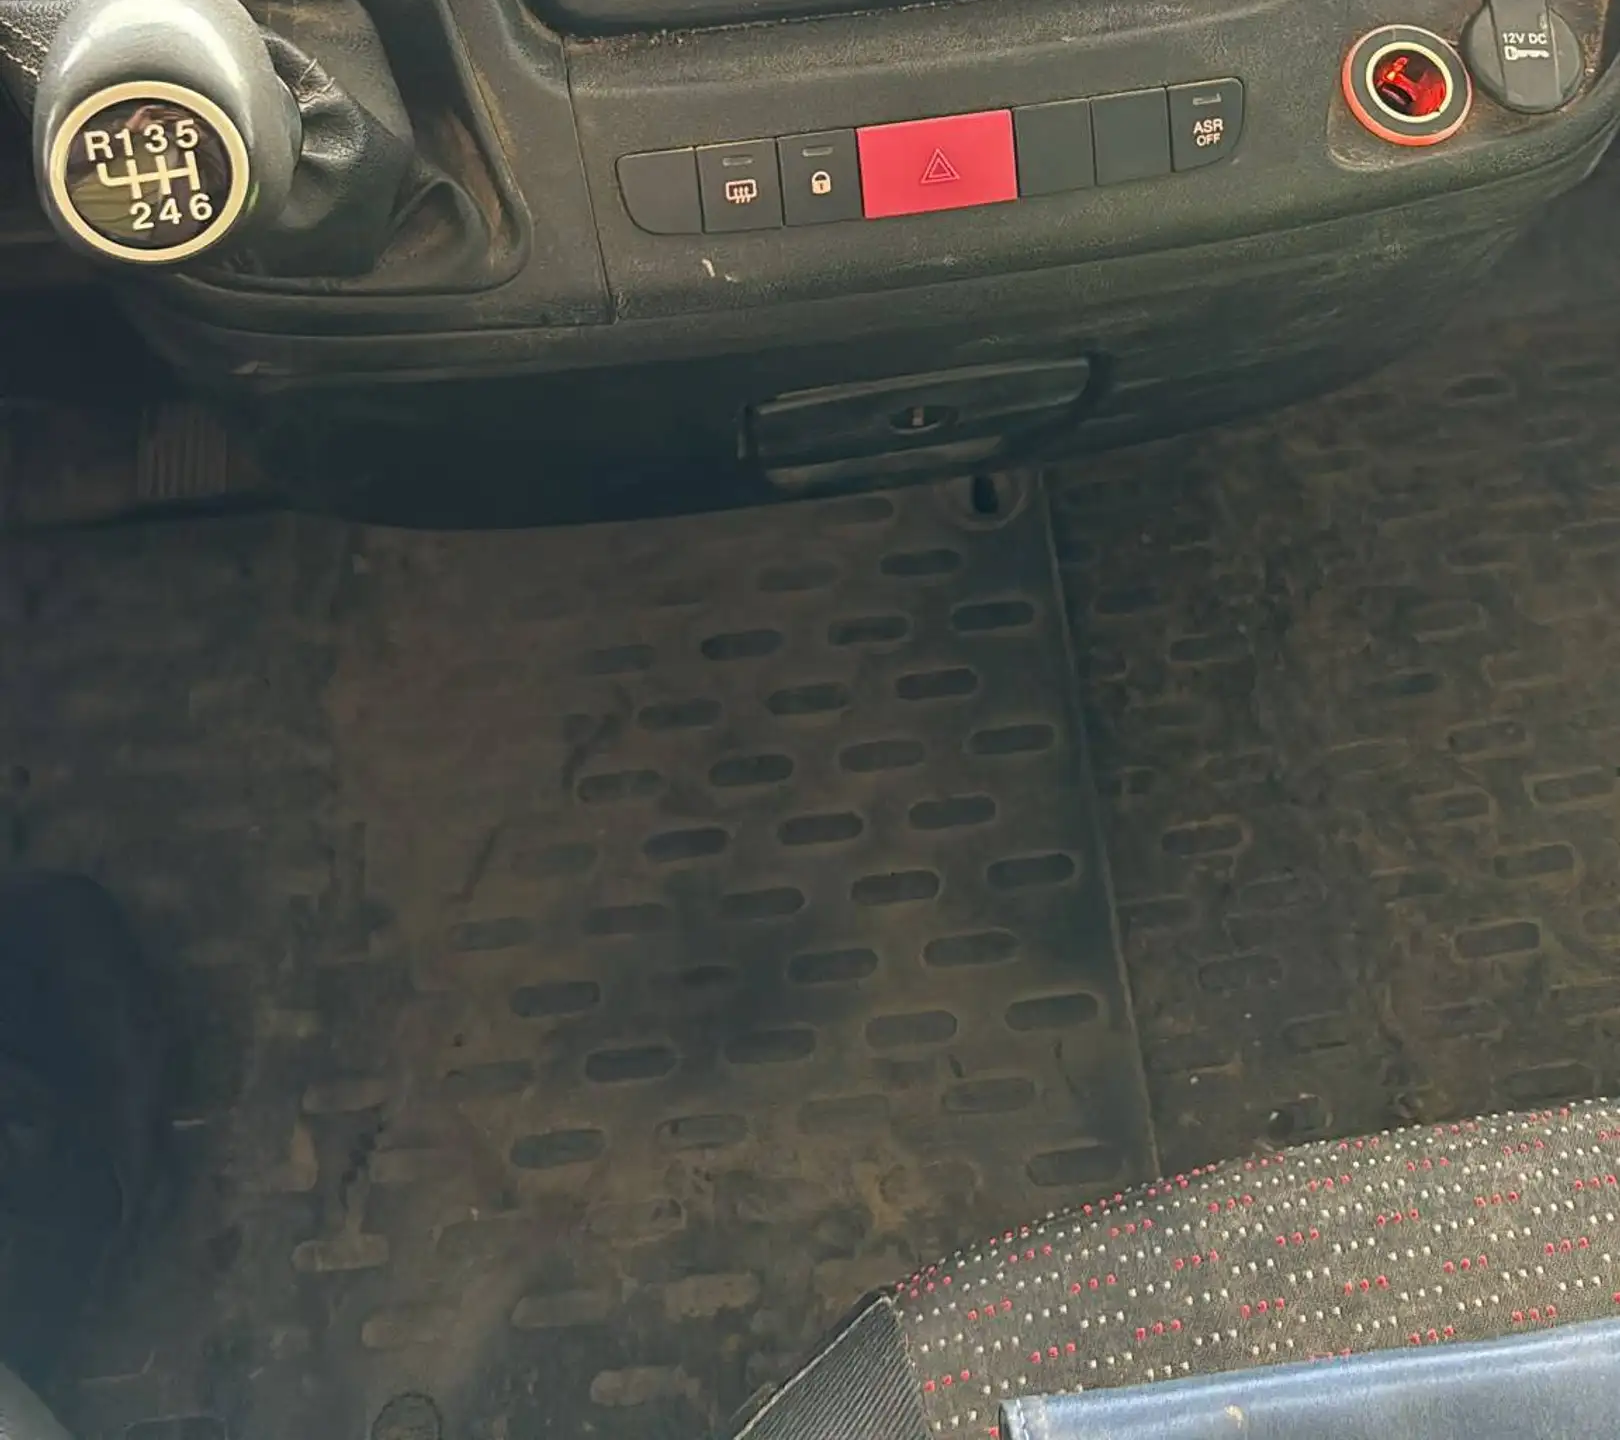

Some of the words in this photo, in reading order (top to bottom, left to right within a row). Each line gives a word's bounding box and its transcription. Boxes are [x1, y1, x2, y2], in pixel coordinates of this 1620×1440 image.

[1502, 32, 1525, 44] 12V
[1528, 32, 1547, 45] DC
[1193, 118, 1224, 135] ASR
[1196, 133, 1220, 147] OFF
